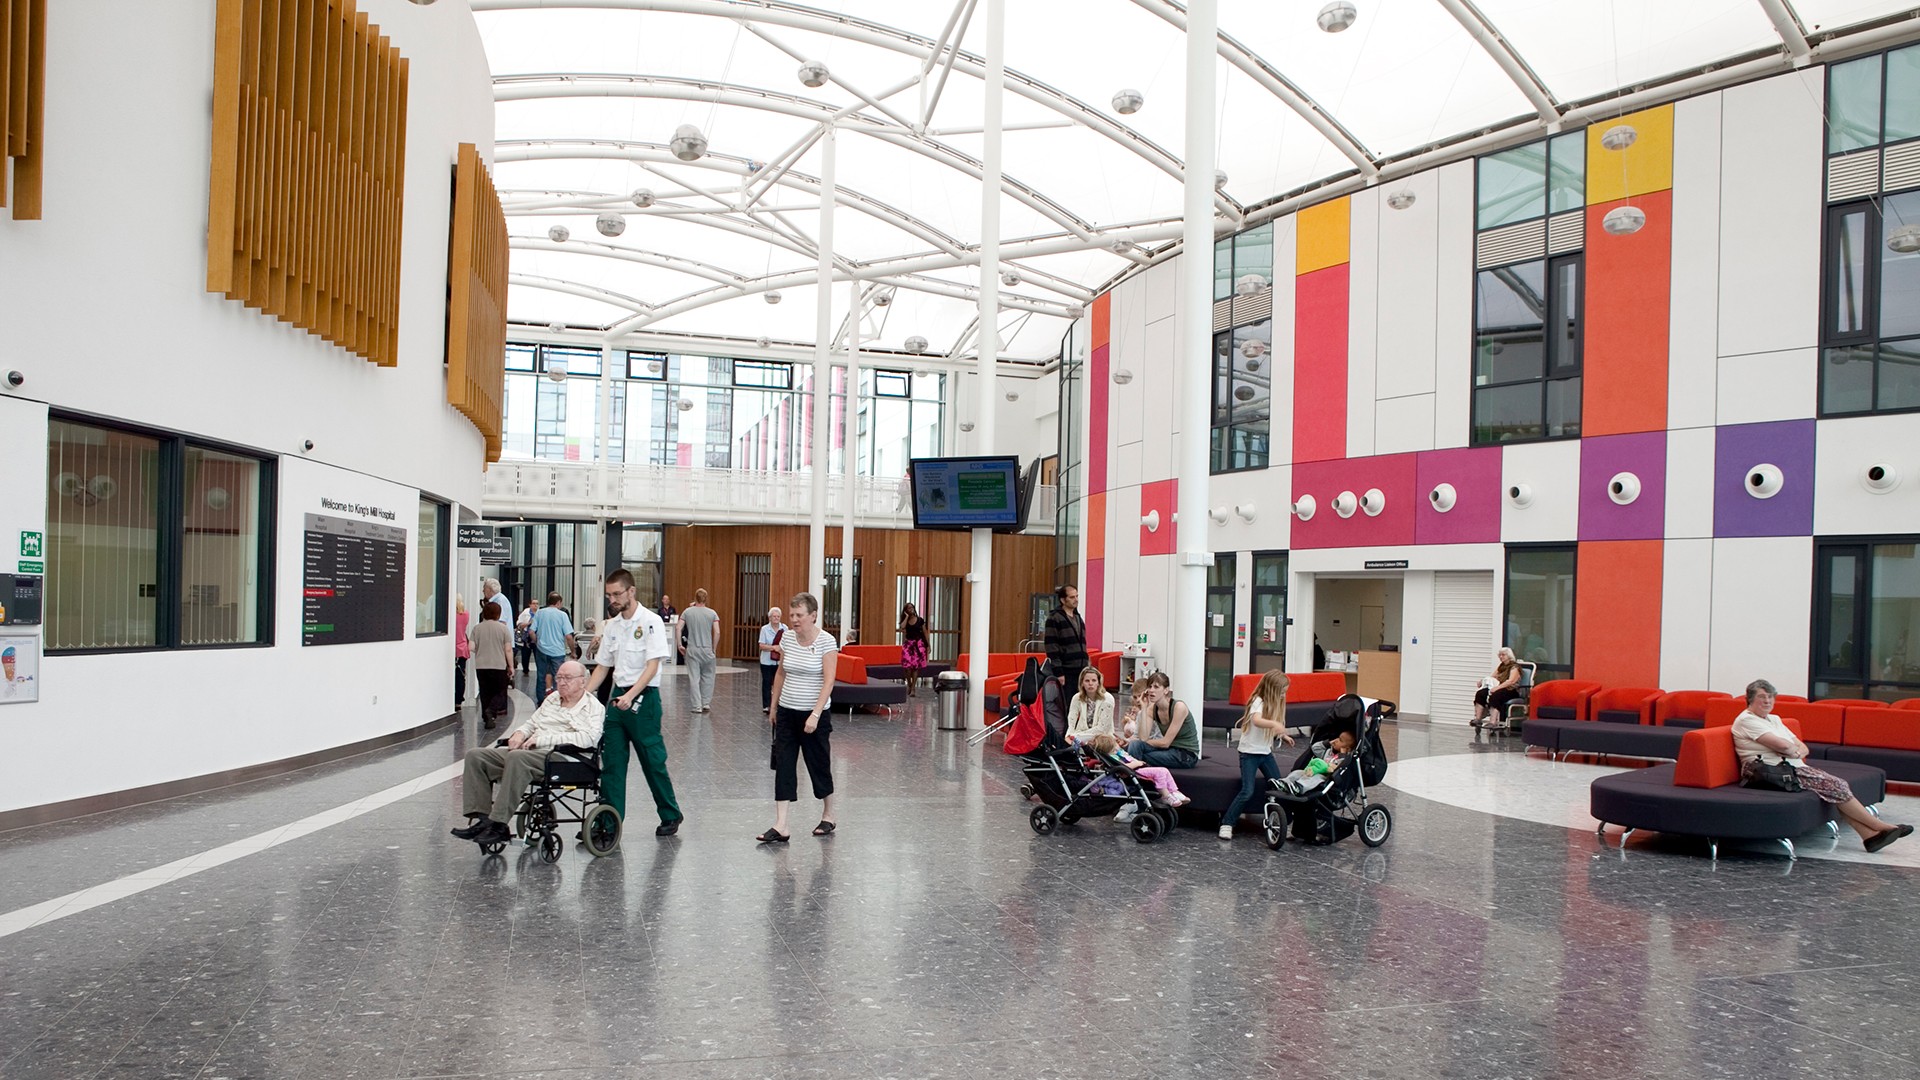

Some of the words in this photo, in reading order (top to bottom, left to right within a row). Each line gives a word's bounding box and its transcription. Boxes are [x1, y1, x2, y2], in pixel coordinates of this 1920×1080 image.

[321, 497, 347, 511] Welcome
[348, 503, 354, 513] to
[354, 503, 369, 517] King's
[370, 507, 378, 517] Mill
[378, 508, 395, 521] Hospital
